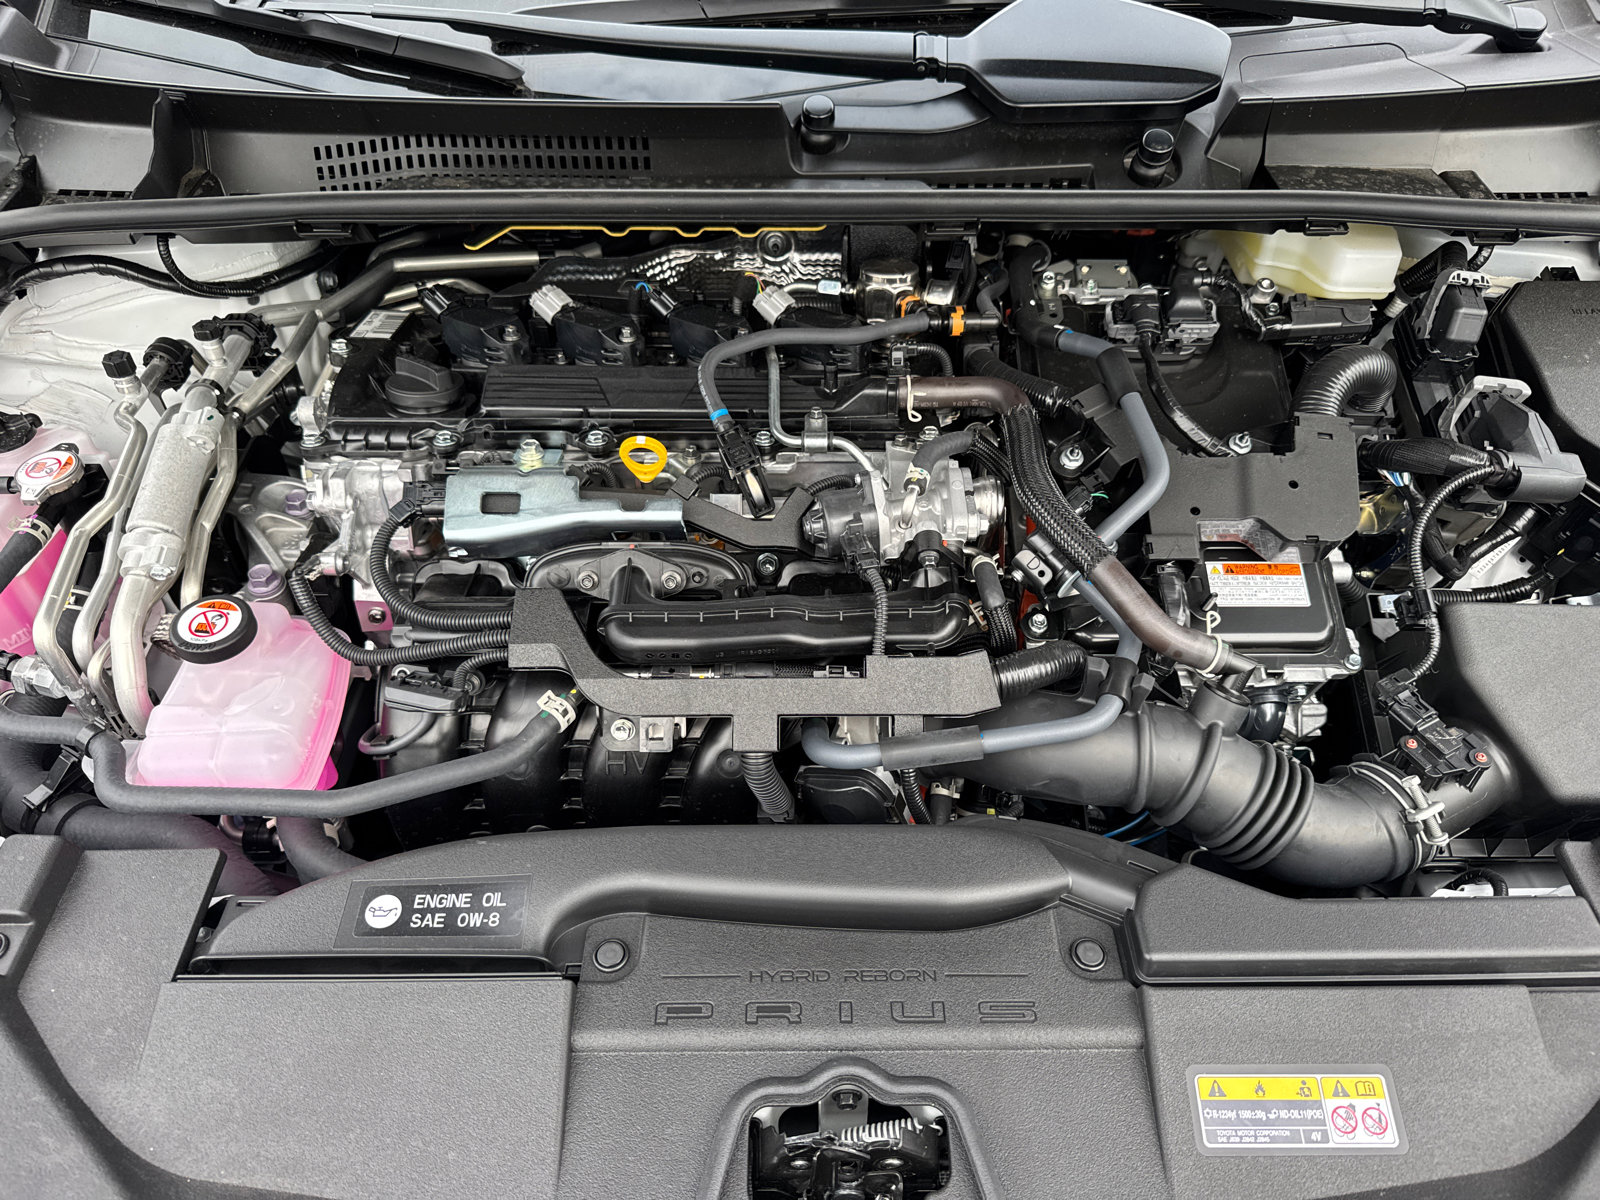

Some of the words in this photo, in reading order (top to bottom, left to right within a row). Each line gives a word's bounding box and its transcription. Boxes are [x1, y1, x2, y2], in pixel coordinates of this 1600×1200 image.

[413, 893, 472, 909] ENGINE
[482, 892, 507, 907] OIL
[410, 913, 446, 928] SAE
[457, 912, 500, 927] 0W-8
[749, 970, 831, 983] HYBRID
[843, 969, 937, 982] REBORN
[654, 1000, 1038, 1025] PRIUS
